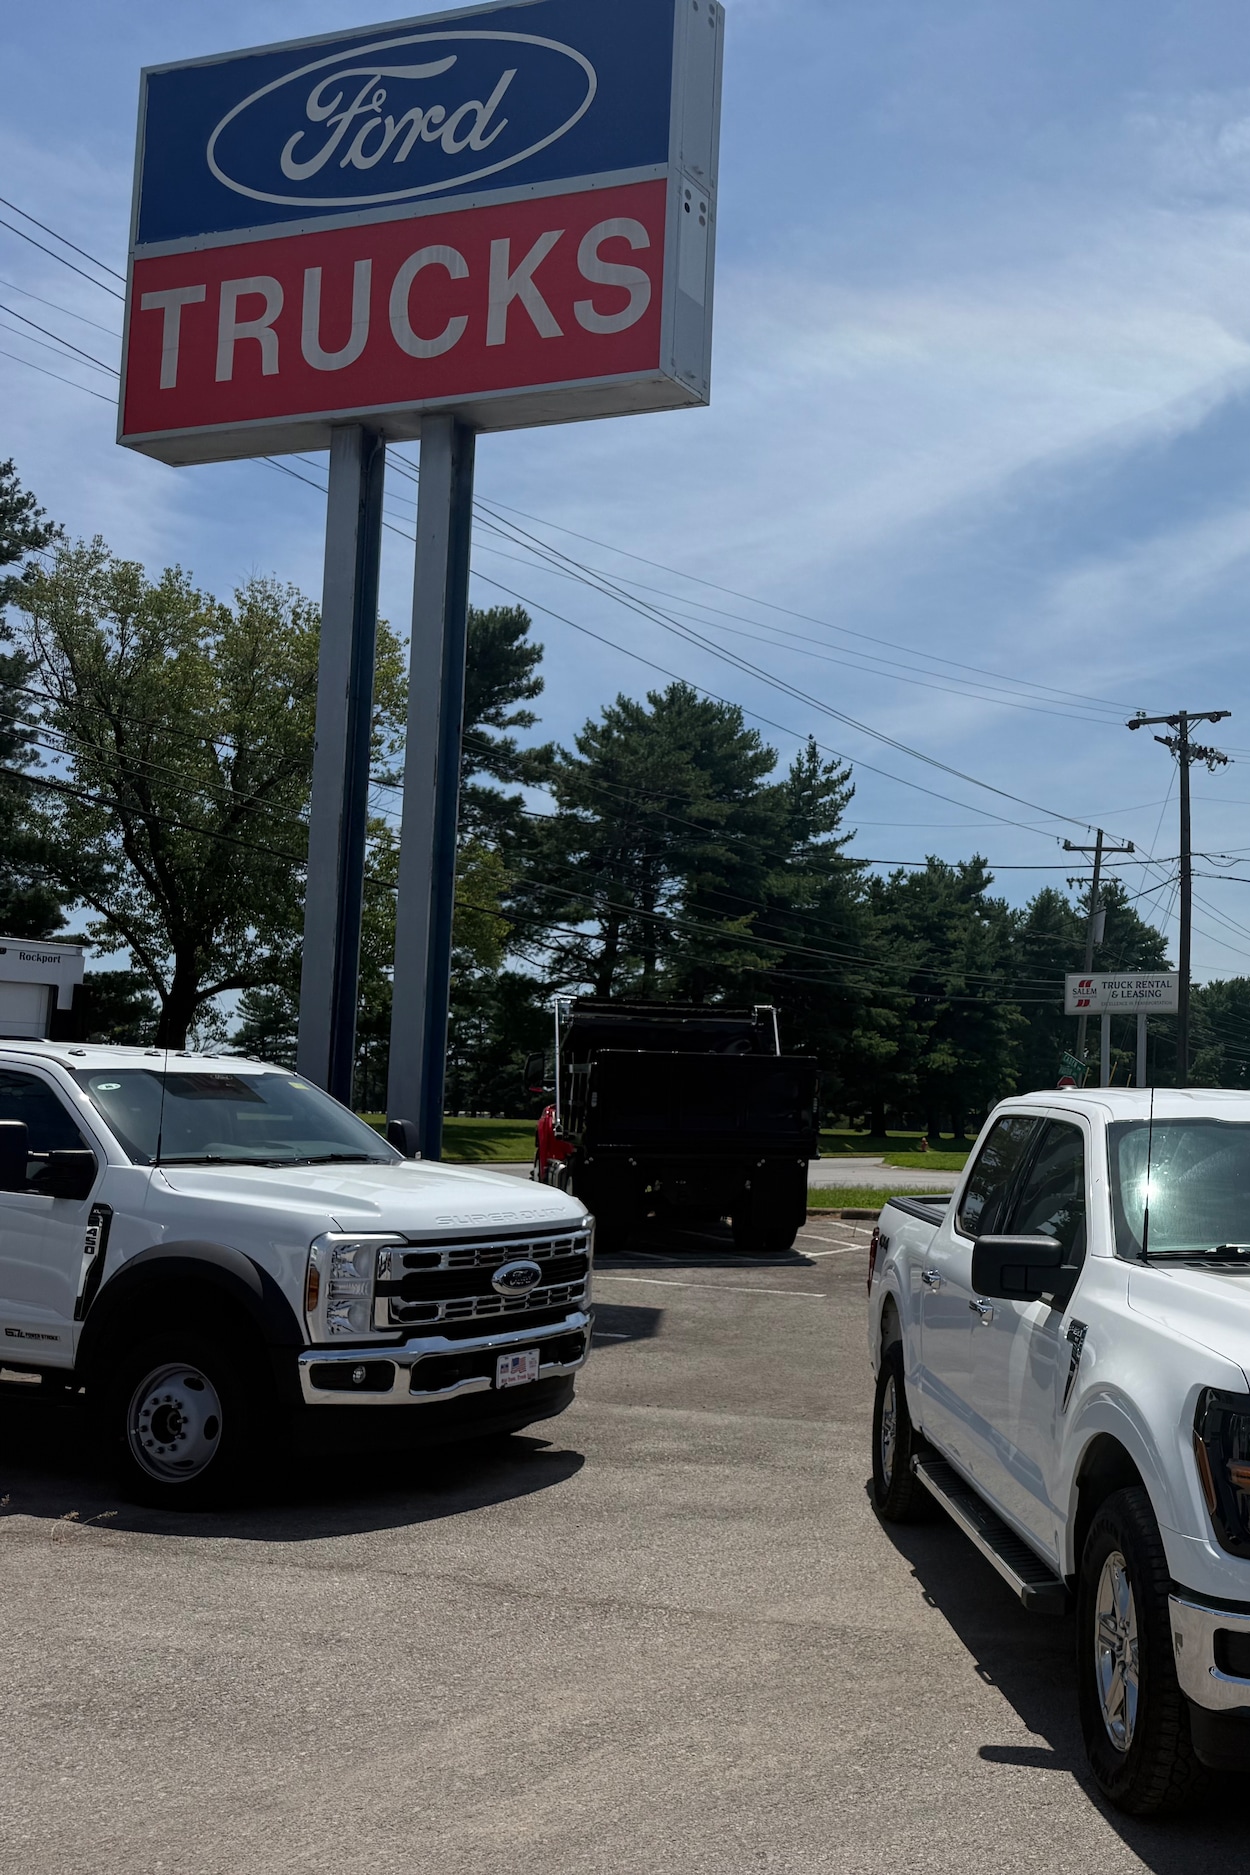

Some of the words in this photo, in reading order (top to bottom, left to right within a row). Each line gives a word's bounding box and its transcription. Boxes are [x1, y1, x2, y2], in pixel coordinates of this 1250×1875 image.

[280, 54, 518, 181] Ford
[140, 217, 652, 390] TRUCKS
[19, 951, 62, 964] Rockport
[1102, 981, 1133, 989] TRUCK
[1135, 980, 1173, 989] RENTAL
[1111, 990, 1119, 998] &
[1121, 990, 1161, 998] LEASING
[436, 1211, 519, 1226] SUPER
[520, 1207, 566, 1220] DUTY
